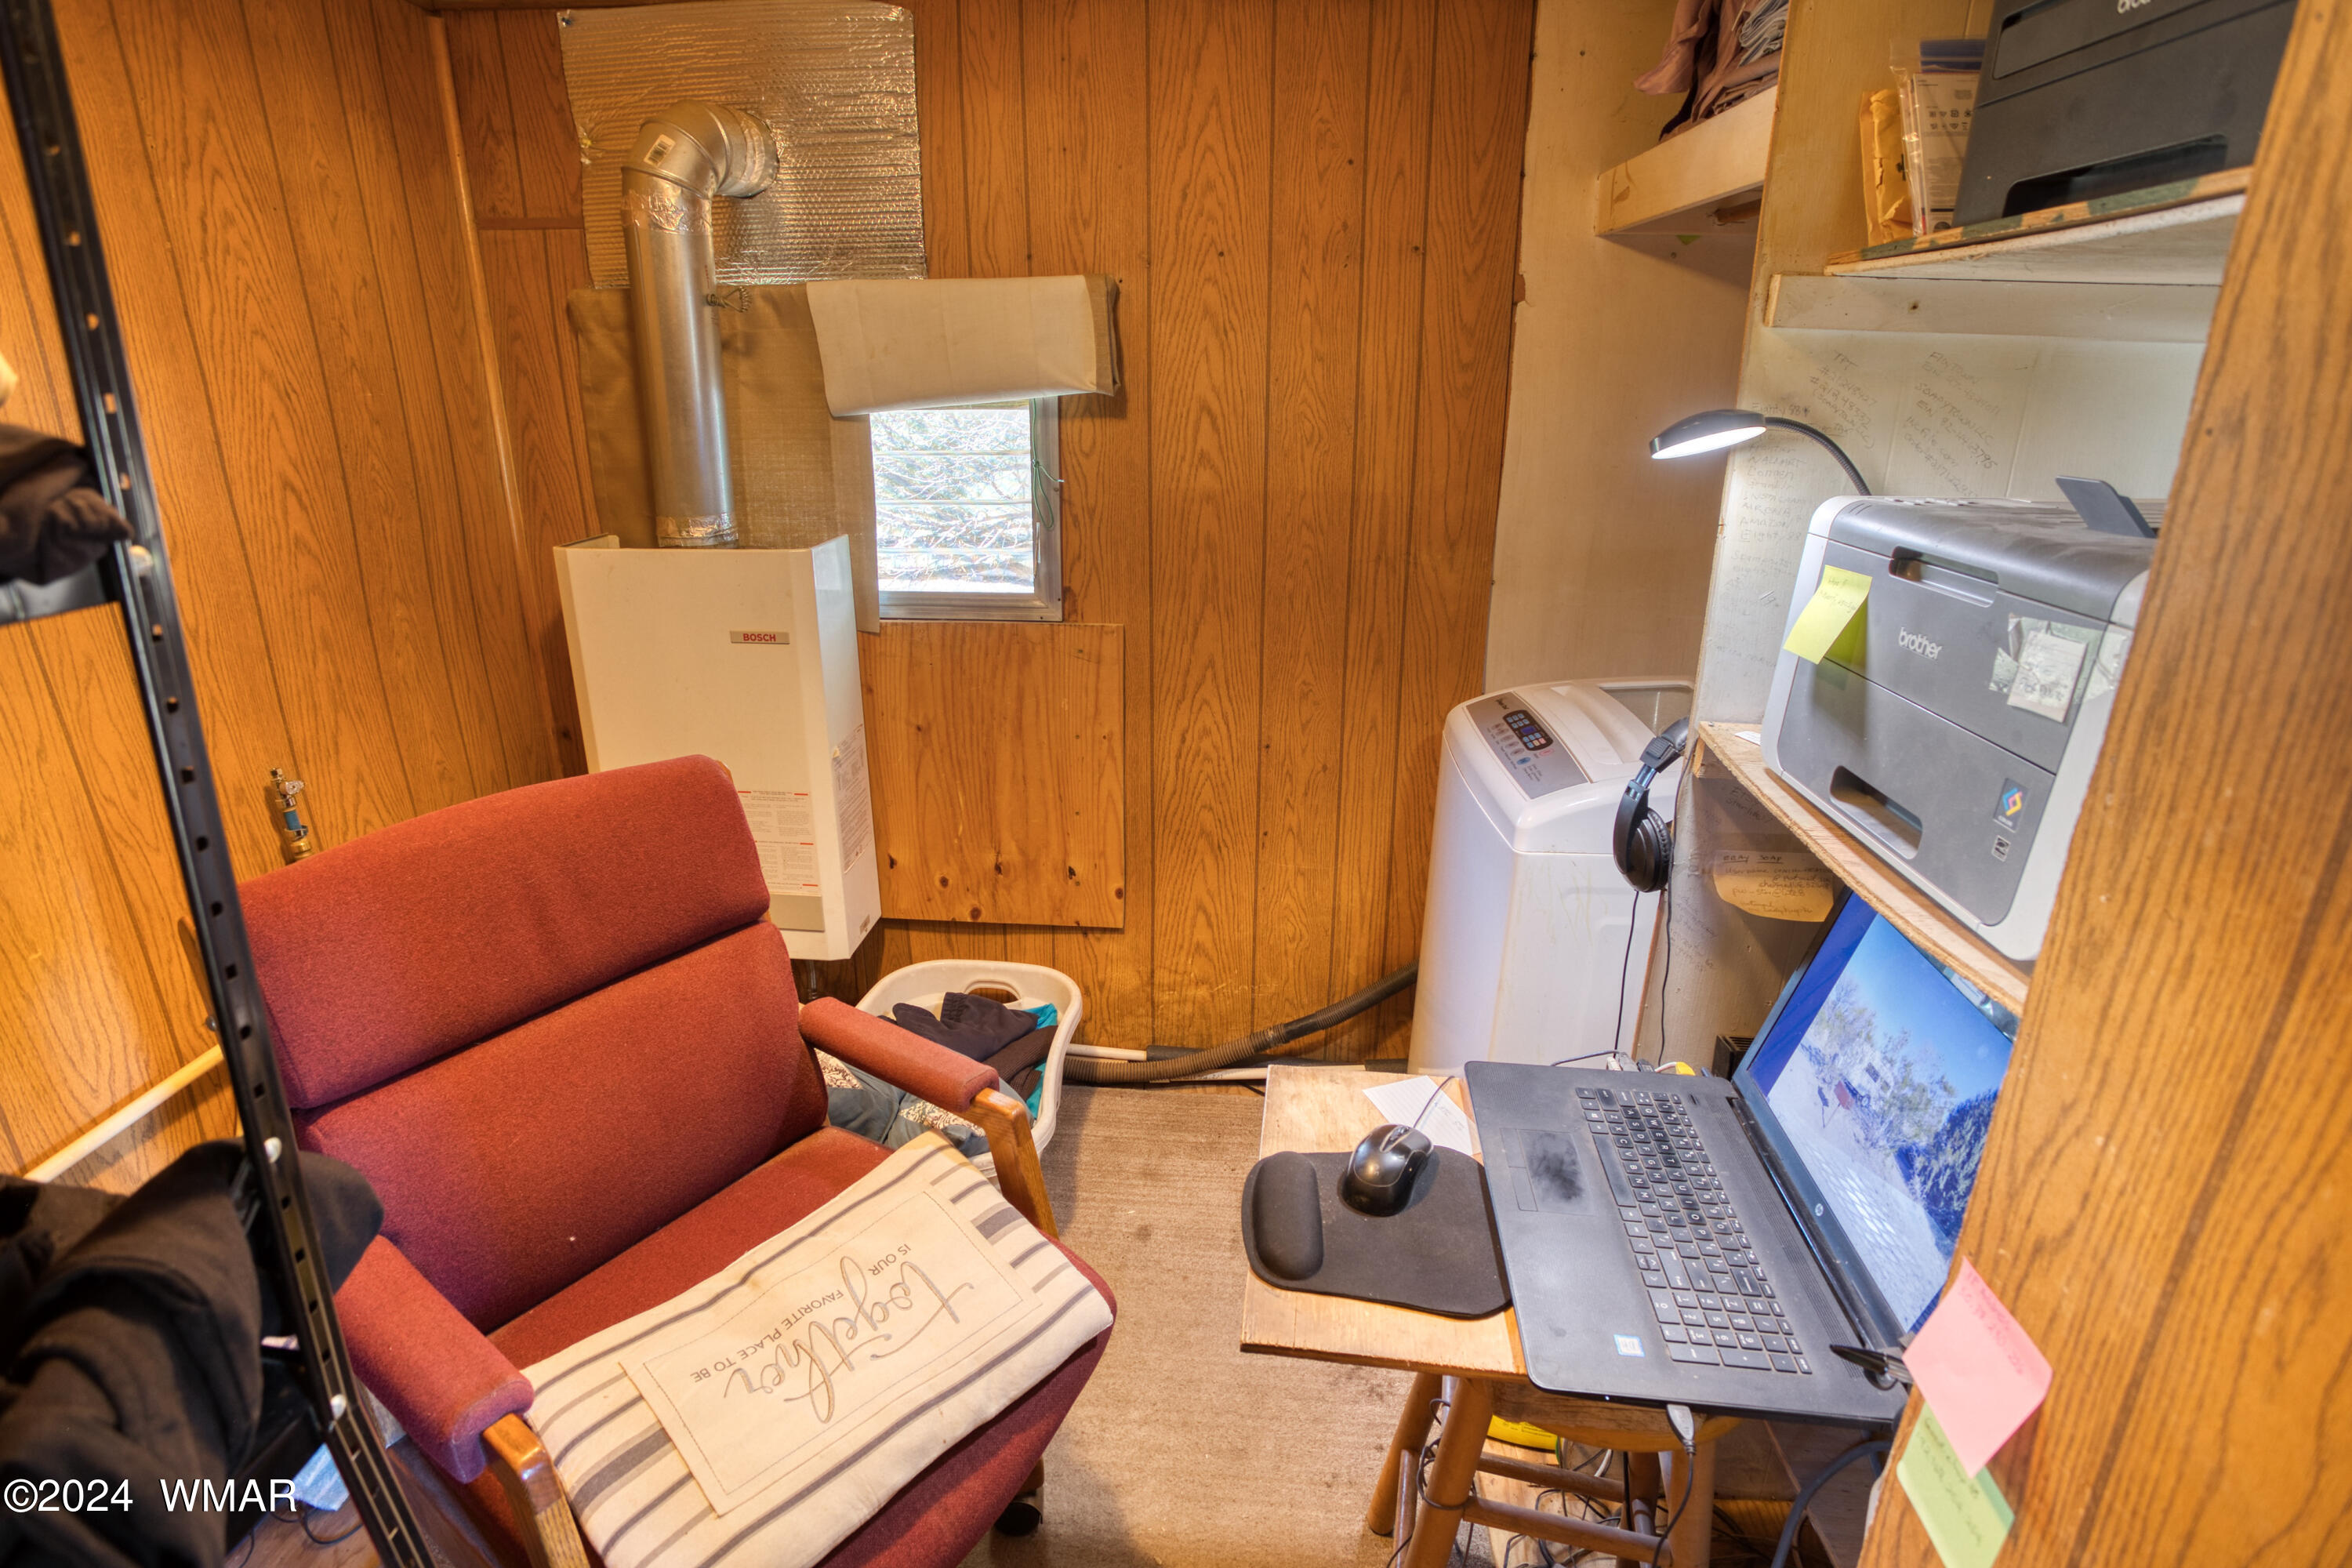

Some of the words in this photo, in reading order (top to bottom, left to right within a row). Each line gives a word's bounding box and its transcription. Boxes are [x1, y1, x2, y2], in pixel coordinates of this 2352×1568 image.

[743, 633, 776, 642] BOSCH
[1899, 626, 1943, 659] brother
[898, 1243, 912, 1256] IS
[867, 1253, 897, 1276] OUR
[782, 1289, 844, 1330] FAVORITE
[723, 1255, 975, 1424] together
[737, 1327, 782, 1361] PLACE
[690, 1369, 712, 1383] BE
[713, 1359, 736, 1373] TO
